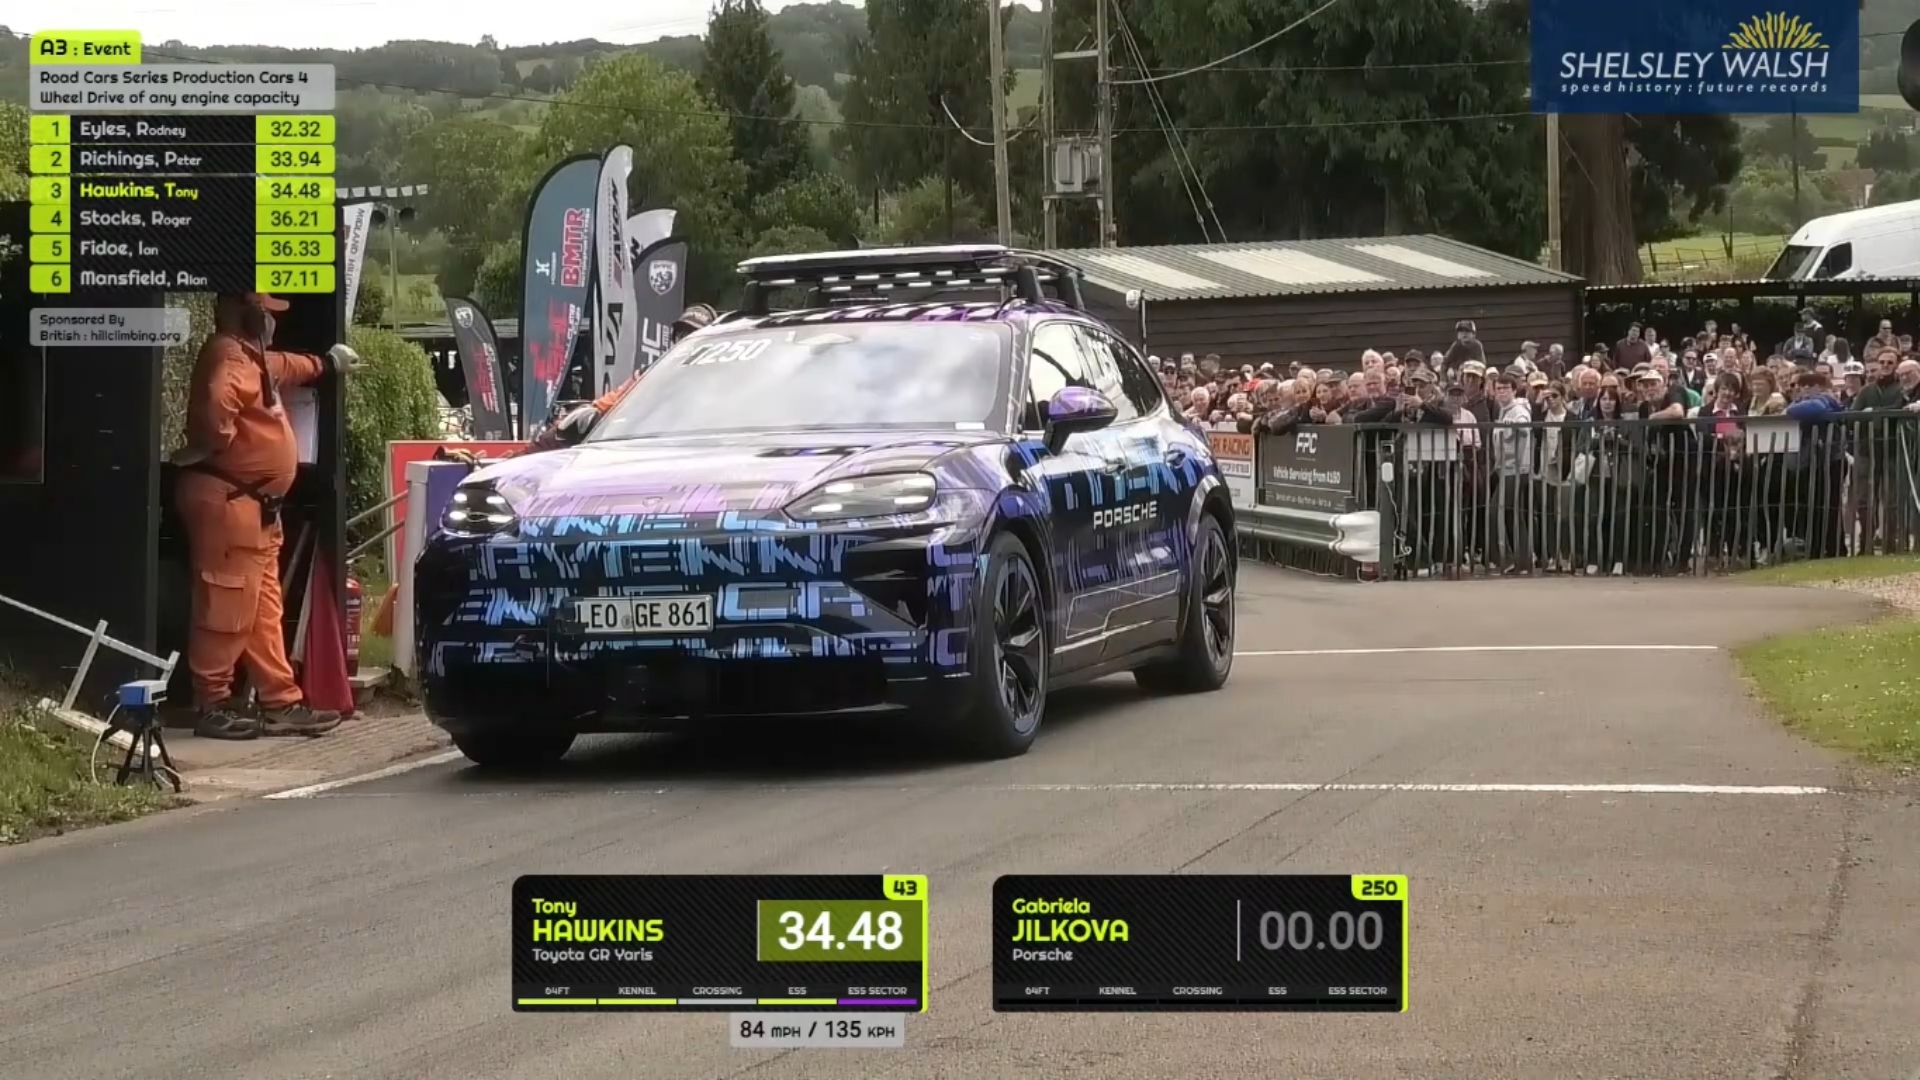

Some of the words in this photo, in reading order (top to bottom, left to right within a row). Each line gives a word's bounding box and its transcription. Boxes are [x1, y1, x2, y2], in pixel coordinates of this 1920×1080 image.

[350, 208, 366, 255] MIDLAND
[611, 178, 621, 263] AVON
[560, 207, 585, 287] BMTR
[1223, 438, 1250, 456] RACING
[1289, 467, 1313, 485] Servicing
[1093, 500, 1157, 530] PORSCHE
[576, 603, 618, 629] LEO
[635, 602, 662, 628] GE
[668, 601, 709, 627] 861
